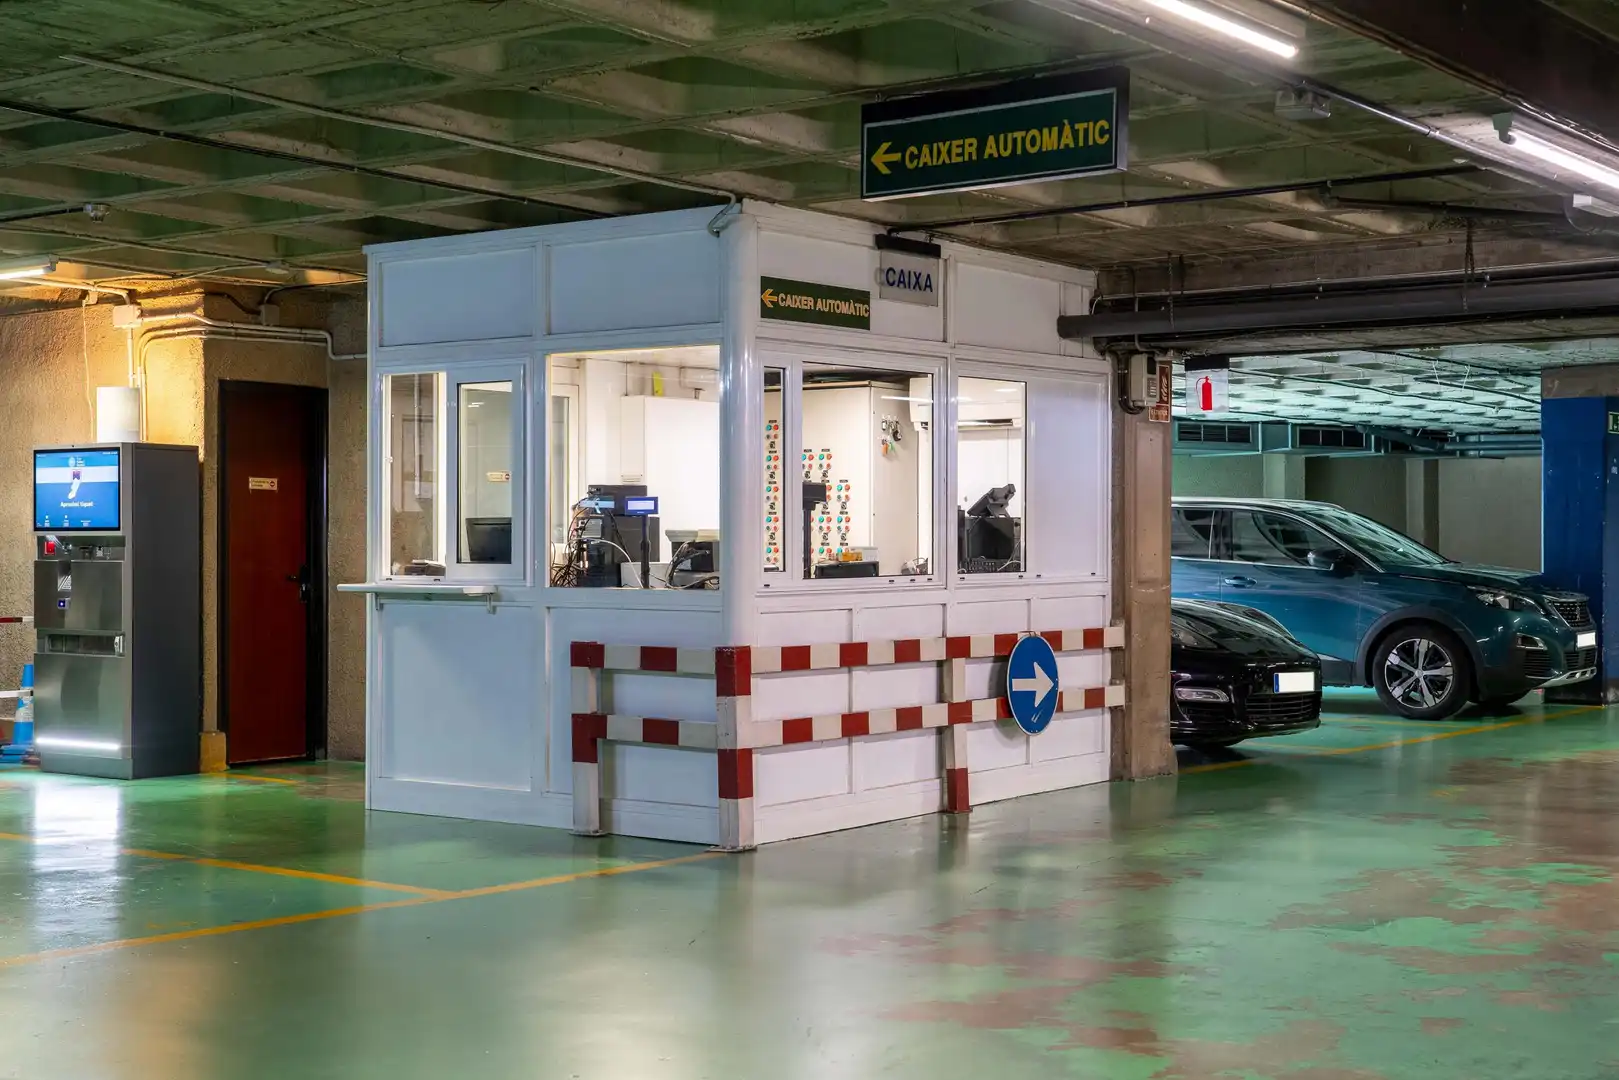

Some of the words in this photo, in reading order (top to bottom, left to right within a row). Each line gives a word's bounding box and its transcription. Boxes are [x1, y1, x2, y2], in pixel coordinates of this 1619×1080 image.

[905, 137, 978, 170] CAIXER
[984, 119, 1110, 159] AUTOMÀTIC
[885, 266, 933, 293] CAIXA
[778, 293, 815, 309] CAIXER
[816, 298, 870, 317] AUTOMÀTIC
